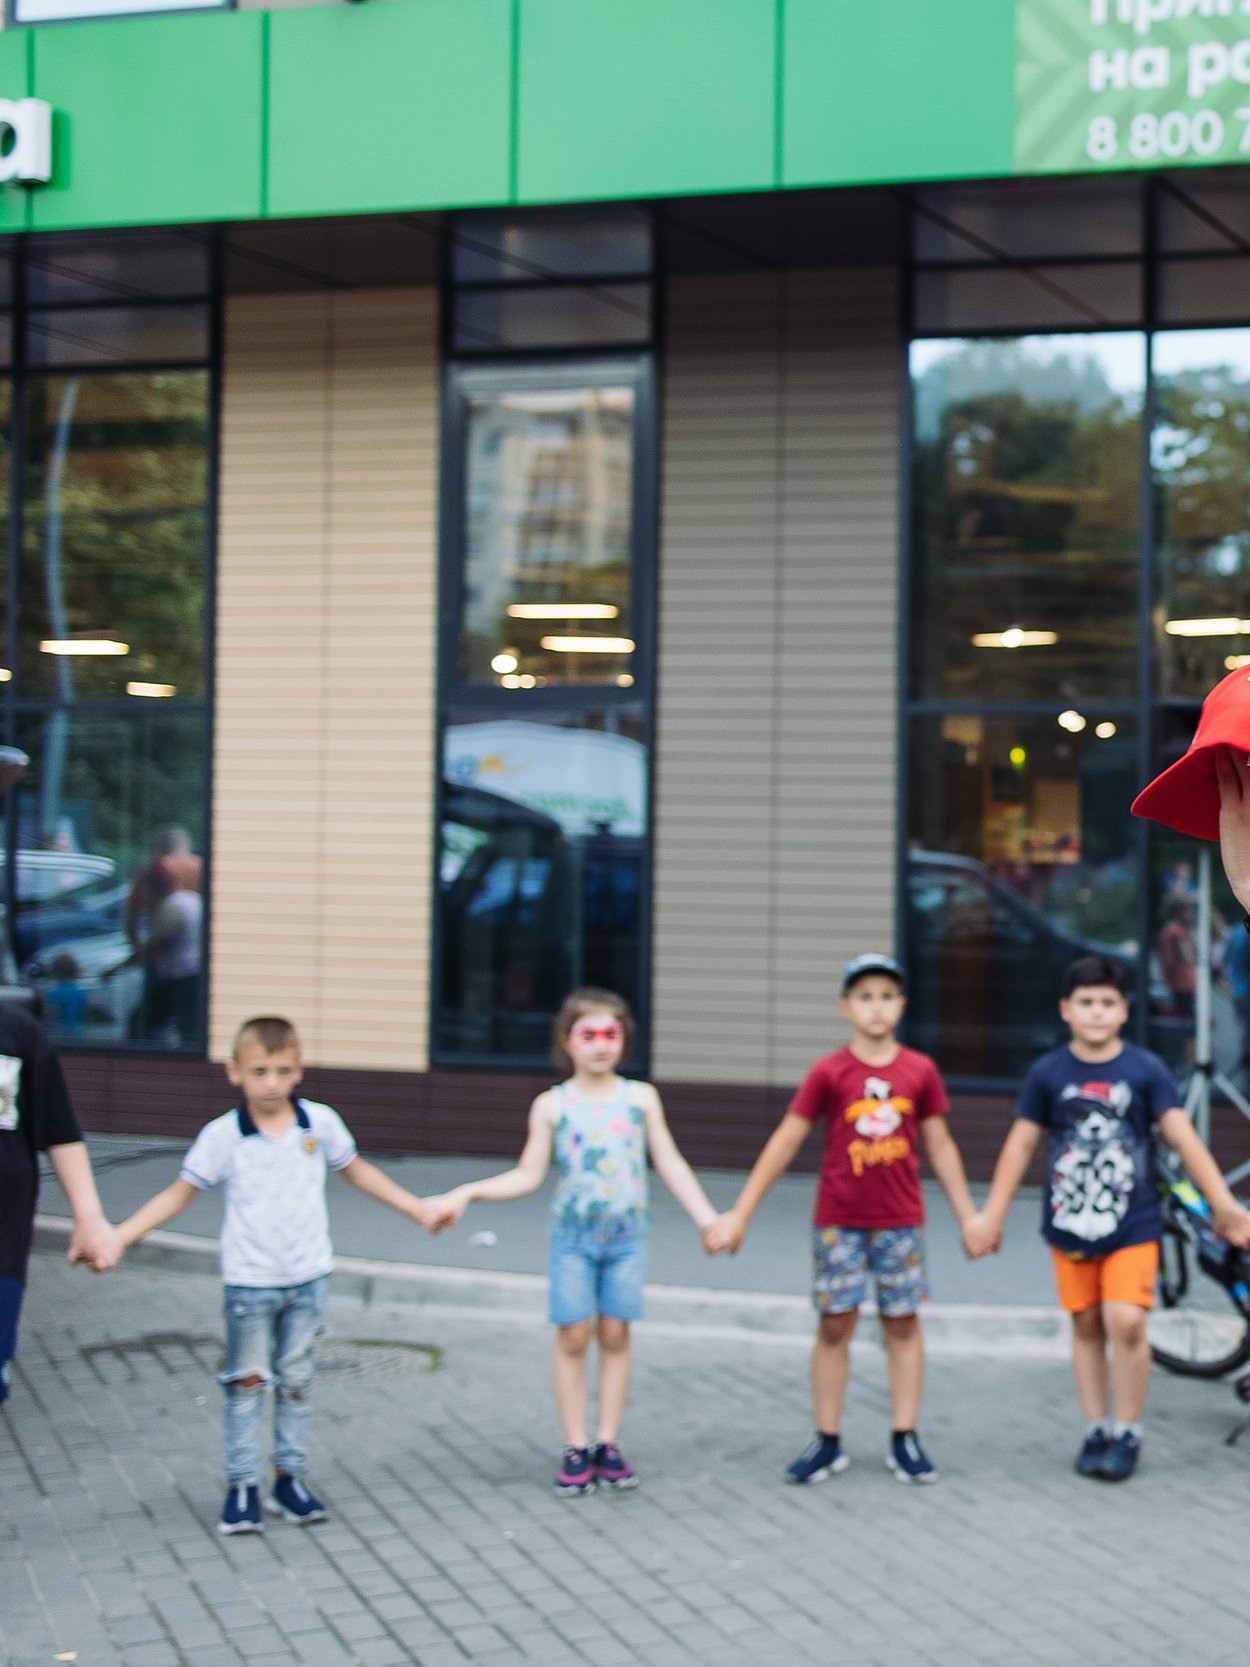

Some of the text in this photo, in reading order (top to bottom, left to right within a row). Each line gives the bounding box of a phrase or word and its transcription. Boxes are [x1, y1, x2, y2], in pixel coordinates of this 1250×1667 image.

[1089, 45, 1169, 91] на
[1087, 115, 1117, 161] 8
[1130, 108, 1223, 158] 800
